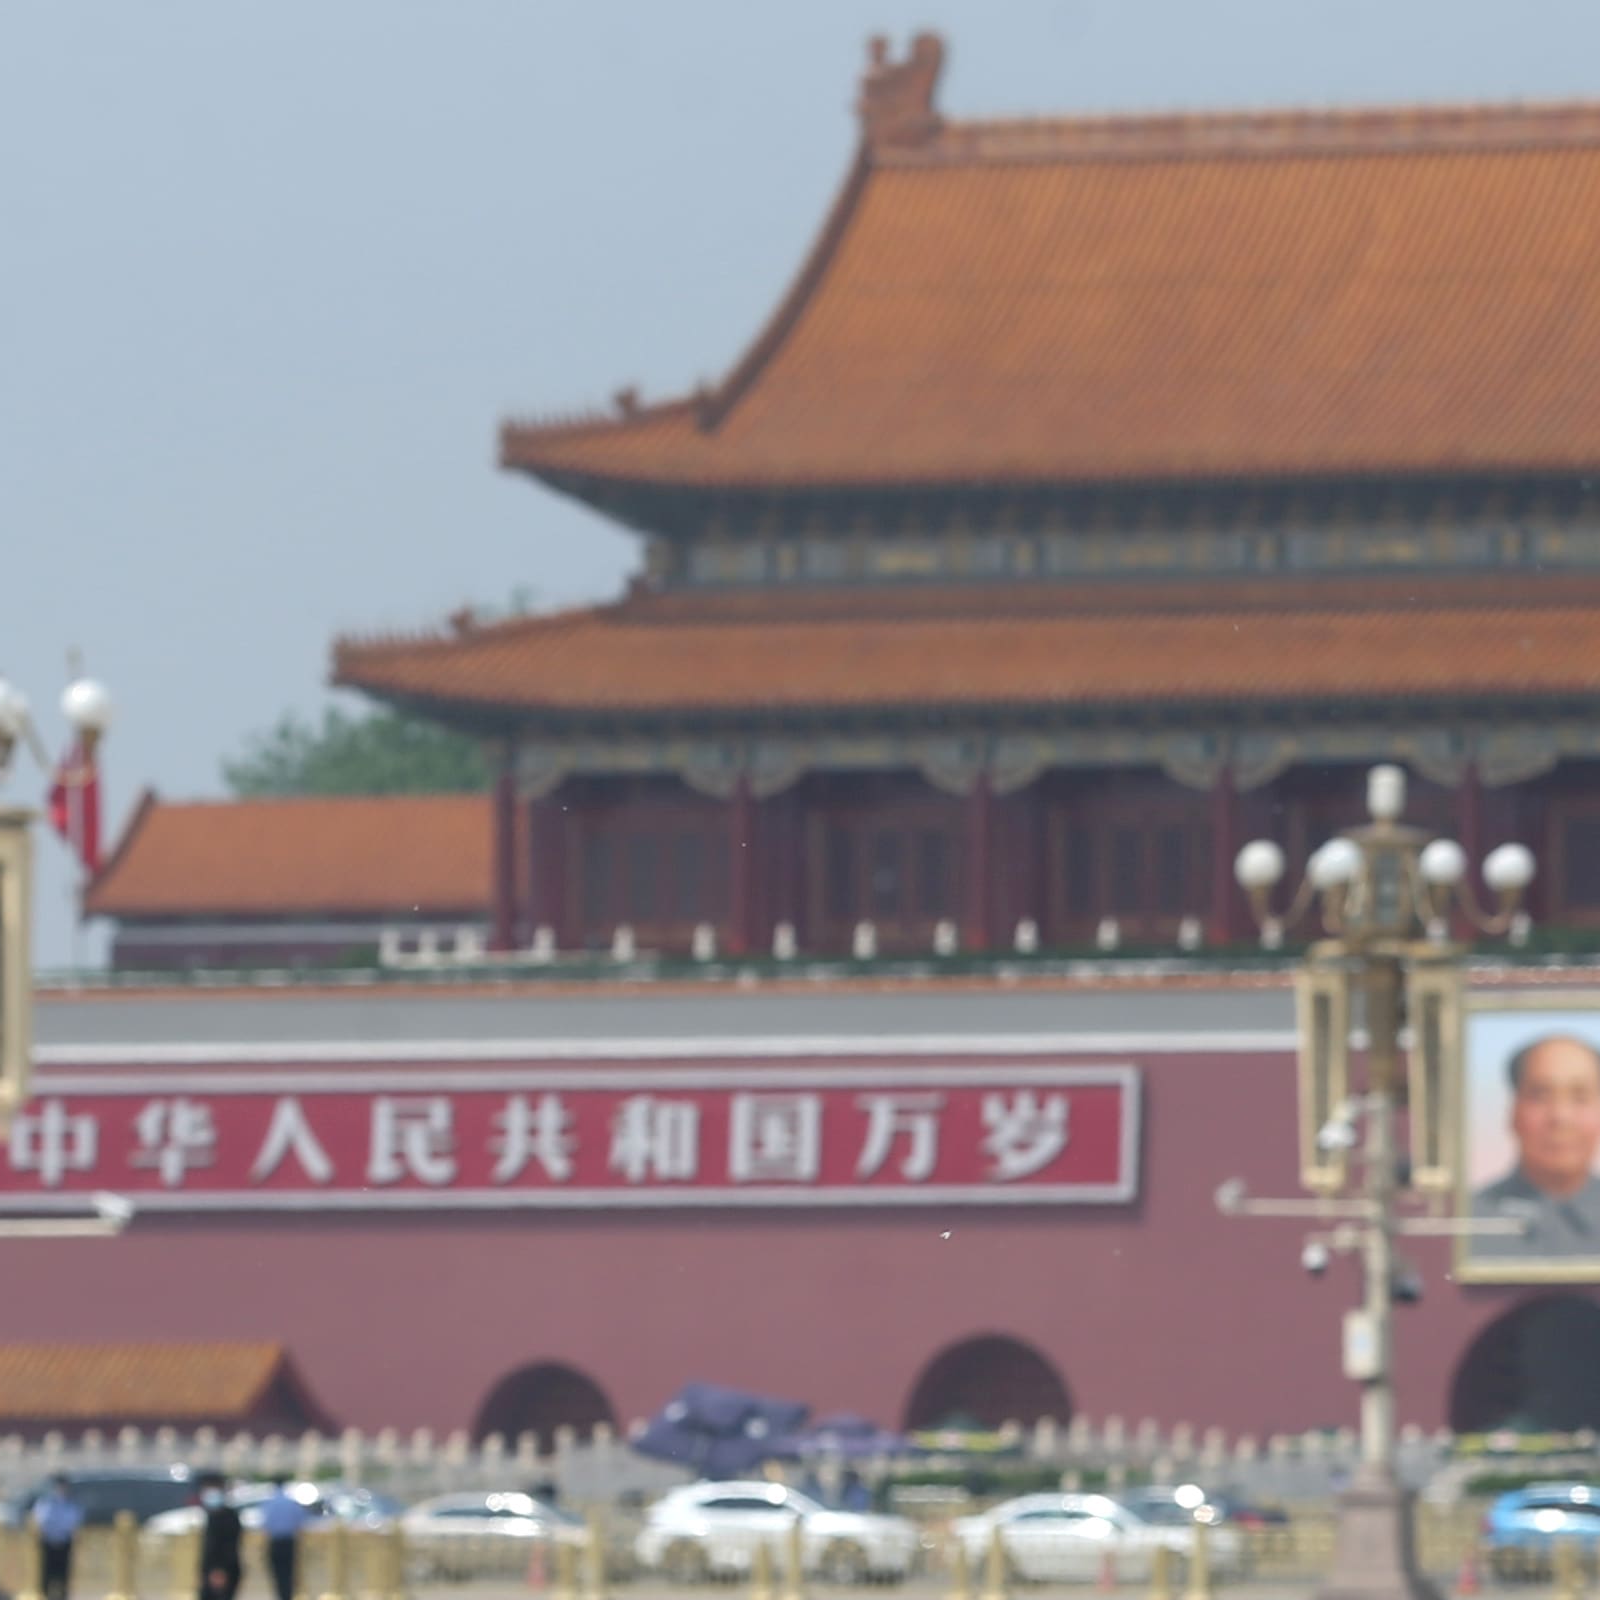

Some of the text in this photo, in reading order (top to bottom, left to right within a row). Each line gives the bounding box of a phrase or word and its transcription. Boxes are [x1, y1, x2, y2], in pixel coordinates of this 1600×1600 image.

[8, 1090, 1070, 1187] 中华人民共和国万岁
